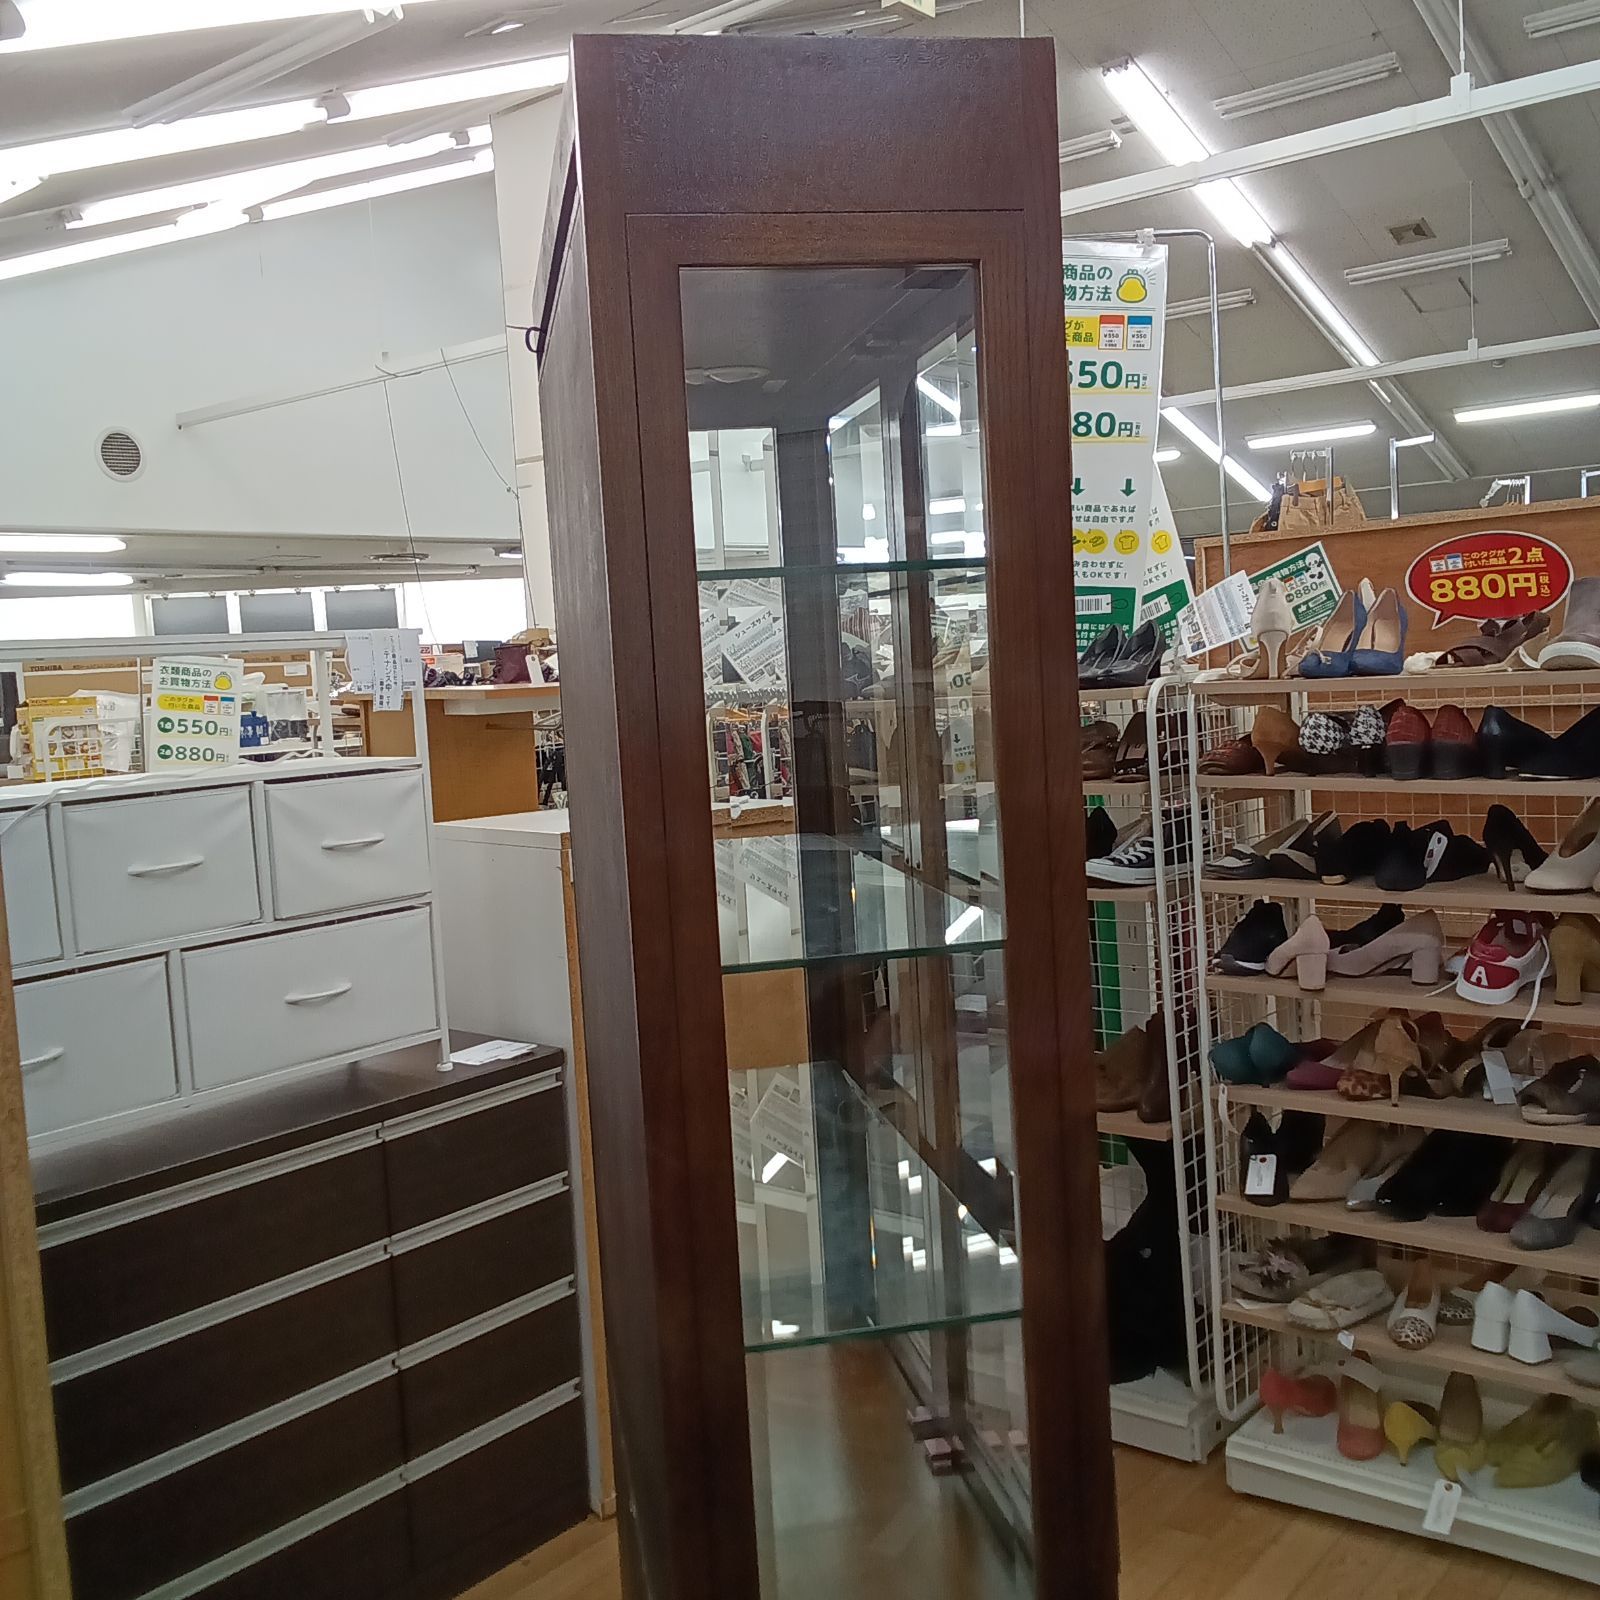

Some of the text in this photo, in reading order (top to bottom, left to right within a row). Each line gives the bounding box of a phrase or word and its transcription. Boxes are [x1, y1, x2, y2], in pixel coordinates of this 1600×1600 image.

[1063, 264, 1113, 281] 商品の
[1072, 515, 1127, 523] せは自由です
[1508, 547, 1544, 565] 2点
[1430, 572, 1538, 603] 880円
[160, 666, 212, 677] 衣類商品の
[160, 677, 211, 688] お買物方法
[1470, 965, 1489, 987] A
